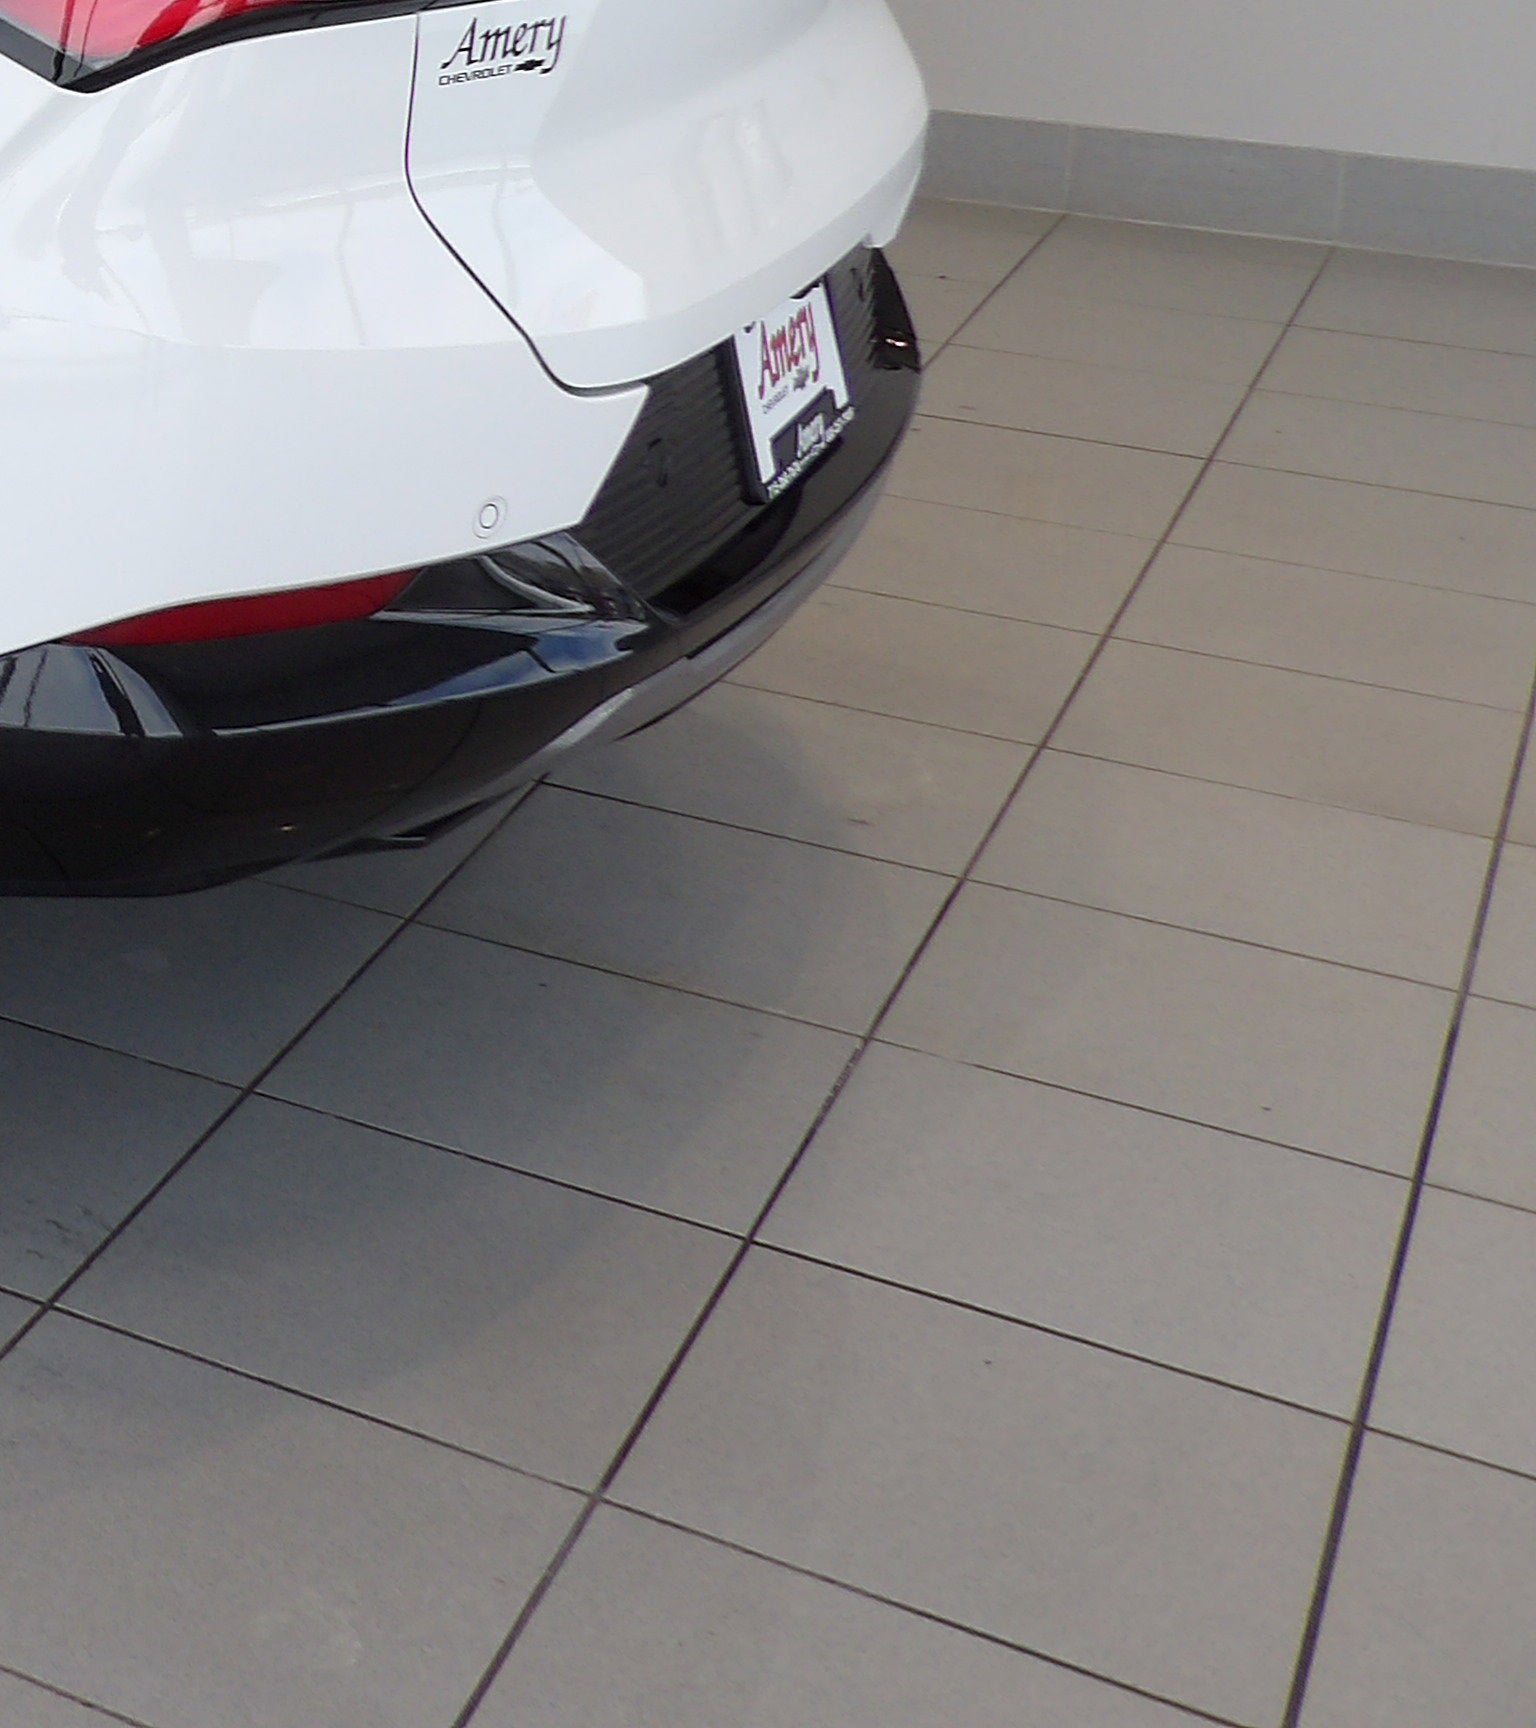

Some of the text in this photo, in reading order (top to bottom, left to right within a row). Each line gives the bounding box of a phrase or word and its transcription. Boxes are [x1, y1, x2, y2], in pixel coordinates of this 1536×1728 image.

[440, 16, 566, 74] Amery
[438, 64, 513, 86] CHEVROLET
[758, 301, 820, 400] Amery
